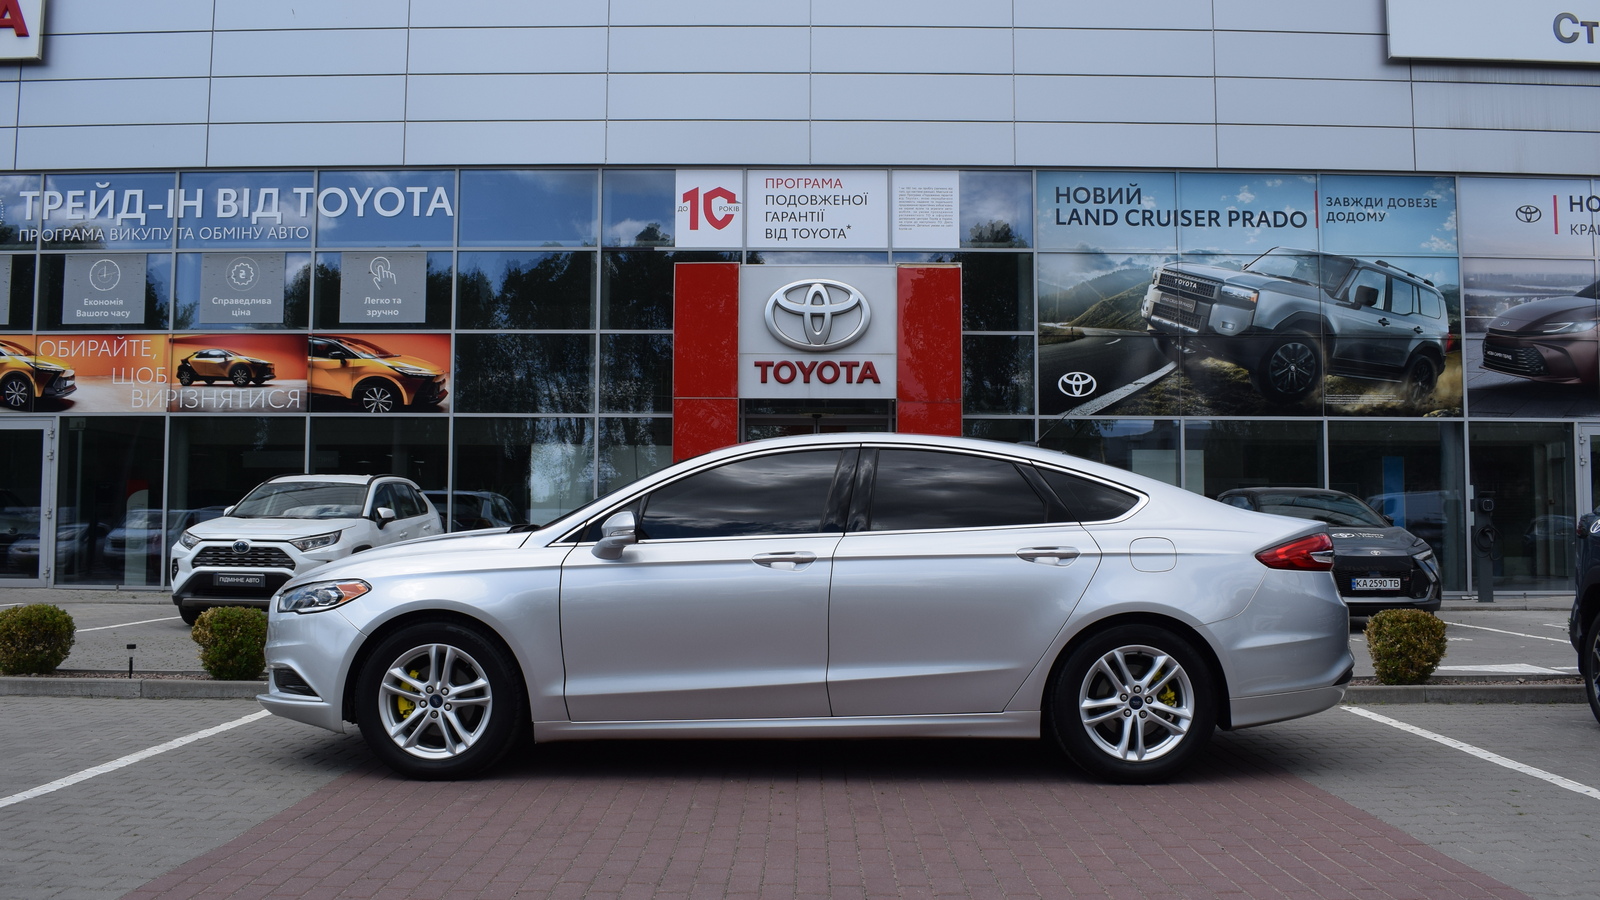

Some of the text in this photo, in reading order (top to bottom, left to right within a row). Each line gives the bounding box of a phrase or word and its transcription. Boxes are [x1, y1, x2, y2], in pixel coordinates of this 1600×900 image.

[765, 177, 843, 189] ПРОГРАМА
[765, 192, 869, 207] ПОДОВЖЕНОЇ
[1055, 183, 1142, 205] НОВИЙ
[19, 182, 454, 226] ТРЕЙД-ІН ВІД TOYOTA
[677, 205, 688, 213] ДО
[1325, 196, 1438, 209] ЗАВЖДИ ДОВЕЗЕ
[765, 209, 826, 222] ГАРАНТІЇ
[1055, 208, 1308, 228] LAND CRUISER PRADO
[1325, 211, 1387, 224] ДОДОМУ
[18, 226, 310, 242] ПРОГРАМА ВИКУПУ ТА ОБМІНУ АВТО
[765, 228, 788, 241] ВІД
[1570, 224, 1600, 235] КРА
[1174, 278, 1197, 289] TOYOTA
[83, 298, 124, 306] Економія
[212, 296, 272, 306] Справедлива
[363, 297, 390, 305] Легко
[76, 309, 131, 319] Вашого часу
[231, 308, 251, 317] ціна
[366, 309, 399, 317] зручно
[39, 336, 157, 359] ОБИРАЙТЕ,
[112, 366, 167, 387] ЩОБ
[754, 360, 881, 384] TOYOTA
[131, 389, 300, 409] ВИРІЗНЯТИСЯ
[1356, 579, 1400, 588] KA 2590 TB
